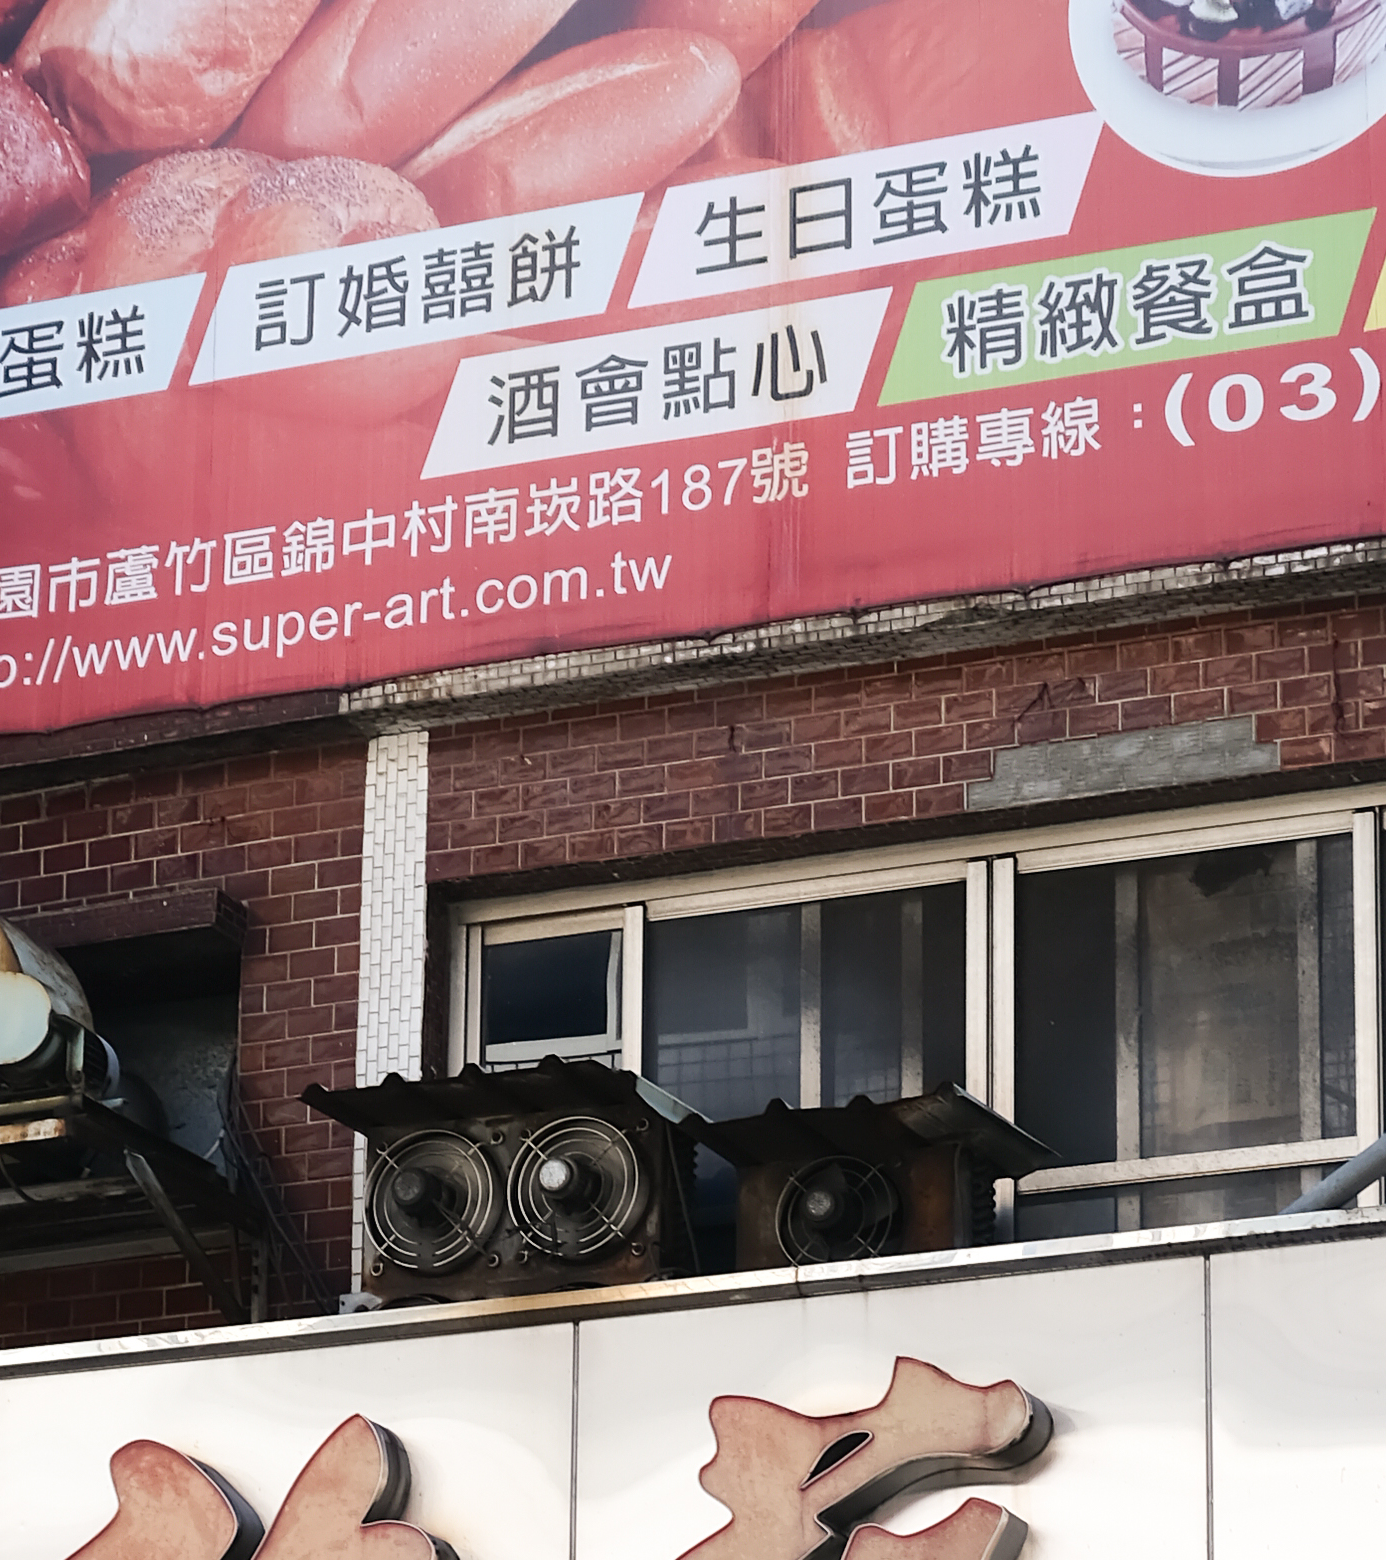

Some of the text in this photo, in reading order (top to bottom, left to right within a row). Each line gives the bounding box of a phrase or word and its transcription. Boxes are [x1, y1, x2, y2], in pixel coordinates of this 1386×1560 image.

[695, 143, 1042, 275] 生日蛋糕
[253, 225, 582, 352] 訂婚囍餅
[945, 244, 1312, 377] 精緻餐盒
[488, 323, 827, 448] 酒會點心
